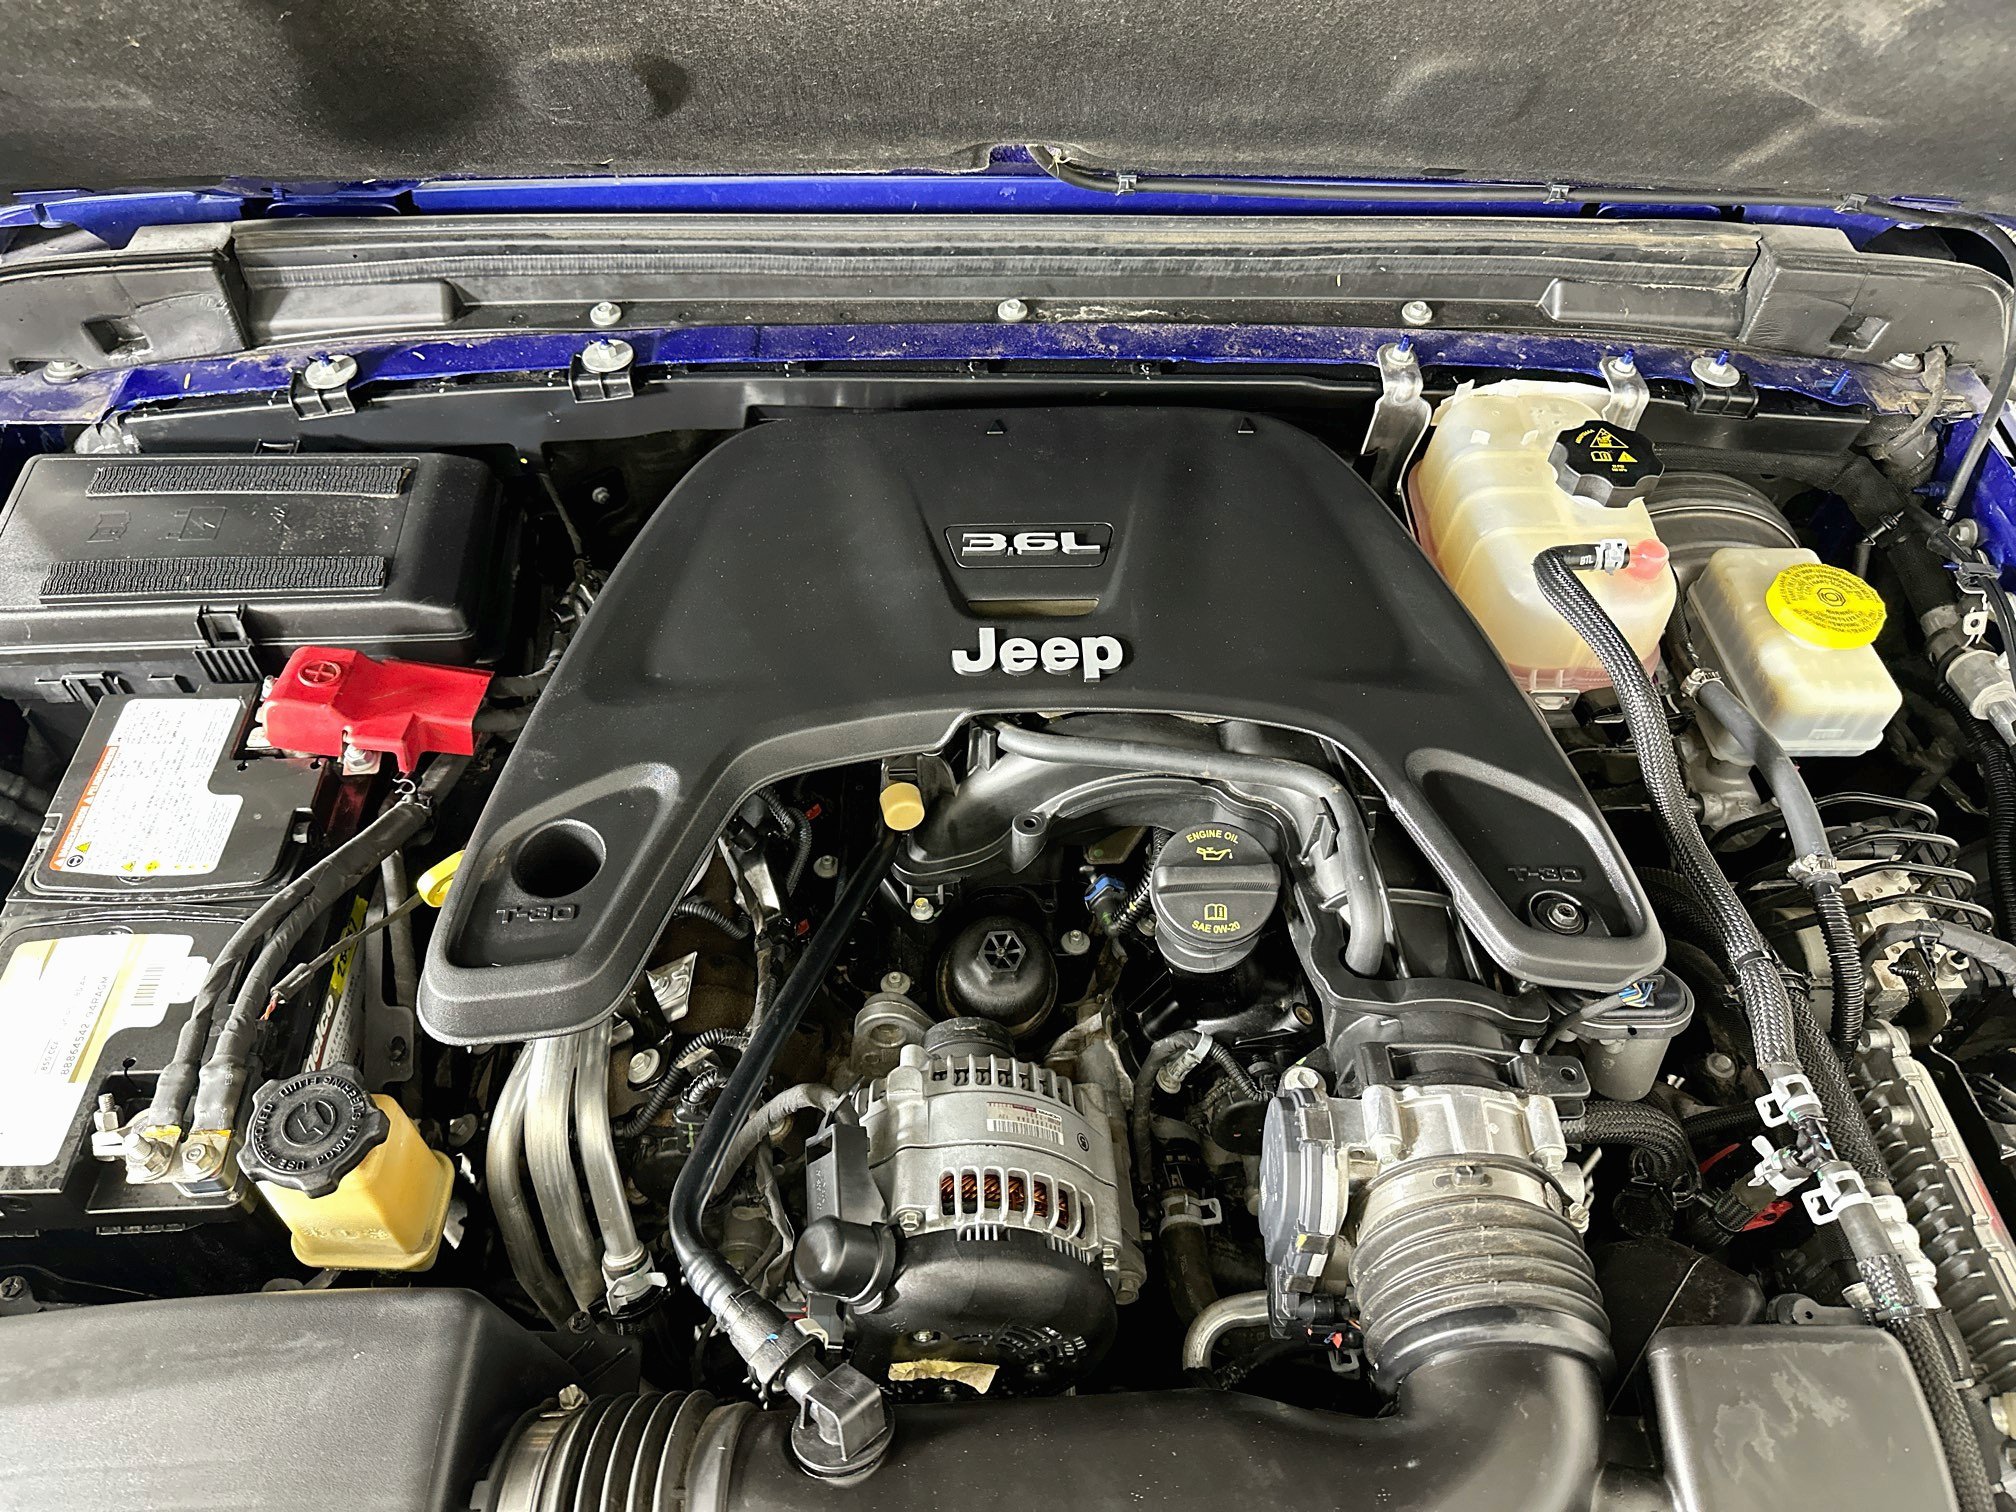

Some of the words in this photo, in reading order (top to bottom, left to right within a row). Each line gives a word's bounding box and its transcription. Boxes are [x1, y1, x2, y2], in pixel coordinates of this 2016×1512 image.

[961, 531, 1101, 556] 3.6L
[951, 627, 1124, 683] Jeep
[1186, 830, 1223, 844] ENGINE
[1224, 831, 1239, 844] OIL
[1192, 920, 1212, 933] SAE
[1213, 921, 1240, 934] 0W-20
[278, 1076, 317, 1098] FLUID
[322, 1075, 367, 1121] STEERING
[254, 1102, 279, 1164] APPROVED
[316, 1123, 360, 1166] POWER
[277, 1159, 306, 1171] USE
